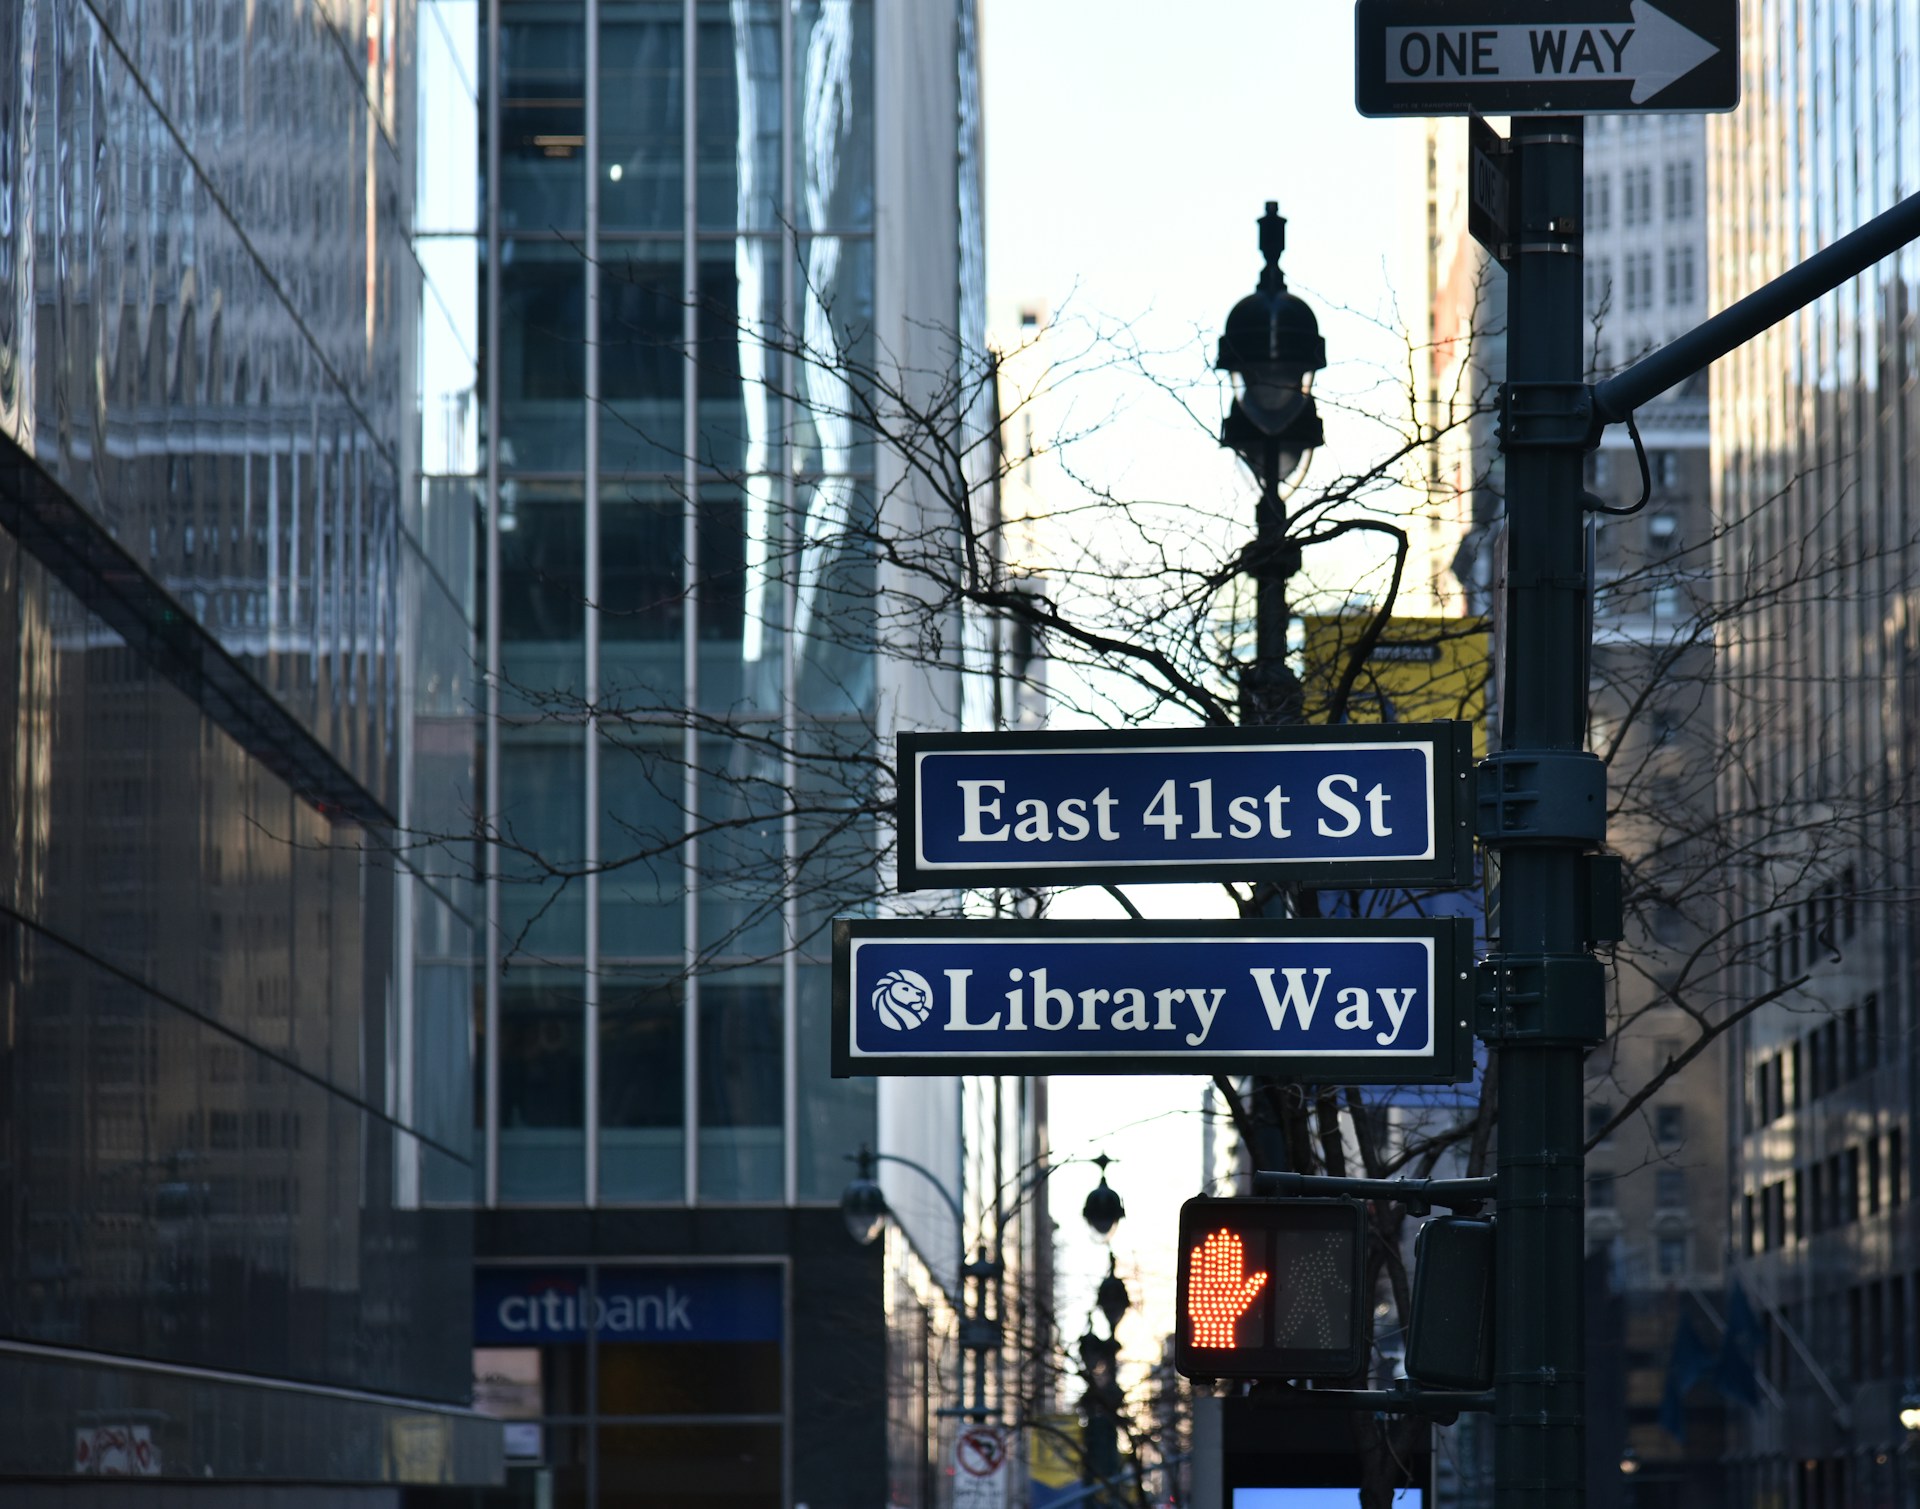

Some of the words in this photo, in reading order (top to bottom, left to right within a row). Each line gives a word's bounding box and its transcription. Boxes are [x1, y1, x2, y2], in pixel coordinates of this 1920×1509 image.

[1400, 32, 1499, 77] ONE
[1529, 29, 1636, 74] WAY
[1478, 158, 1497, 217] ONE
[957, 779, 1120, 842] East
[1143, 779, 1292, 841] 41st
[1316, 774, 1393, 838] St
[943, 968, 1226, 1046] Library
[1250, 968, 1417, 1046] Way
[498, 1284, 693, 1332] citibank
